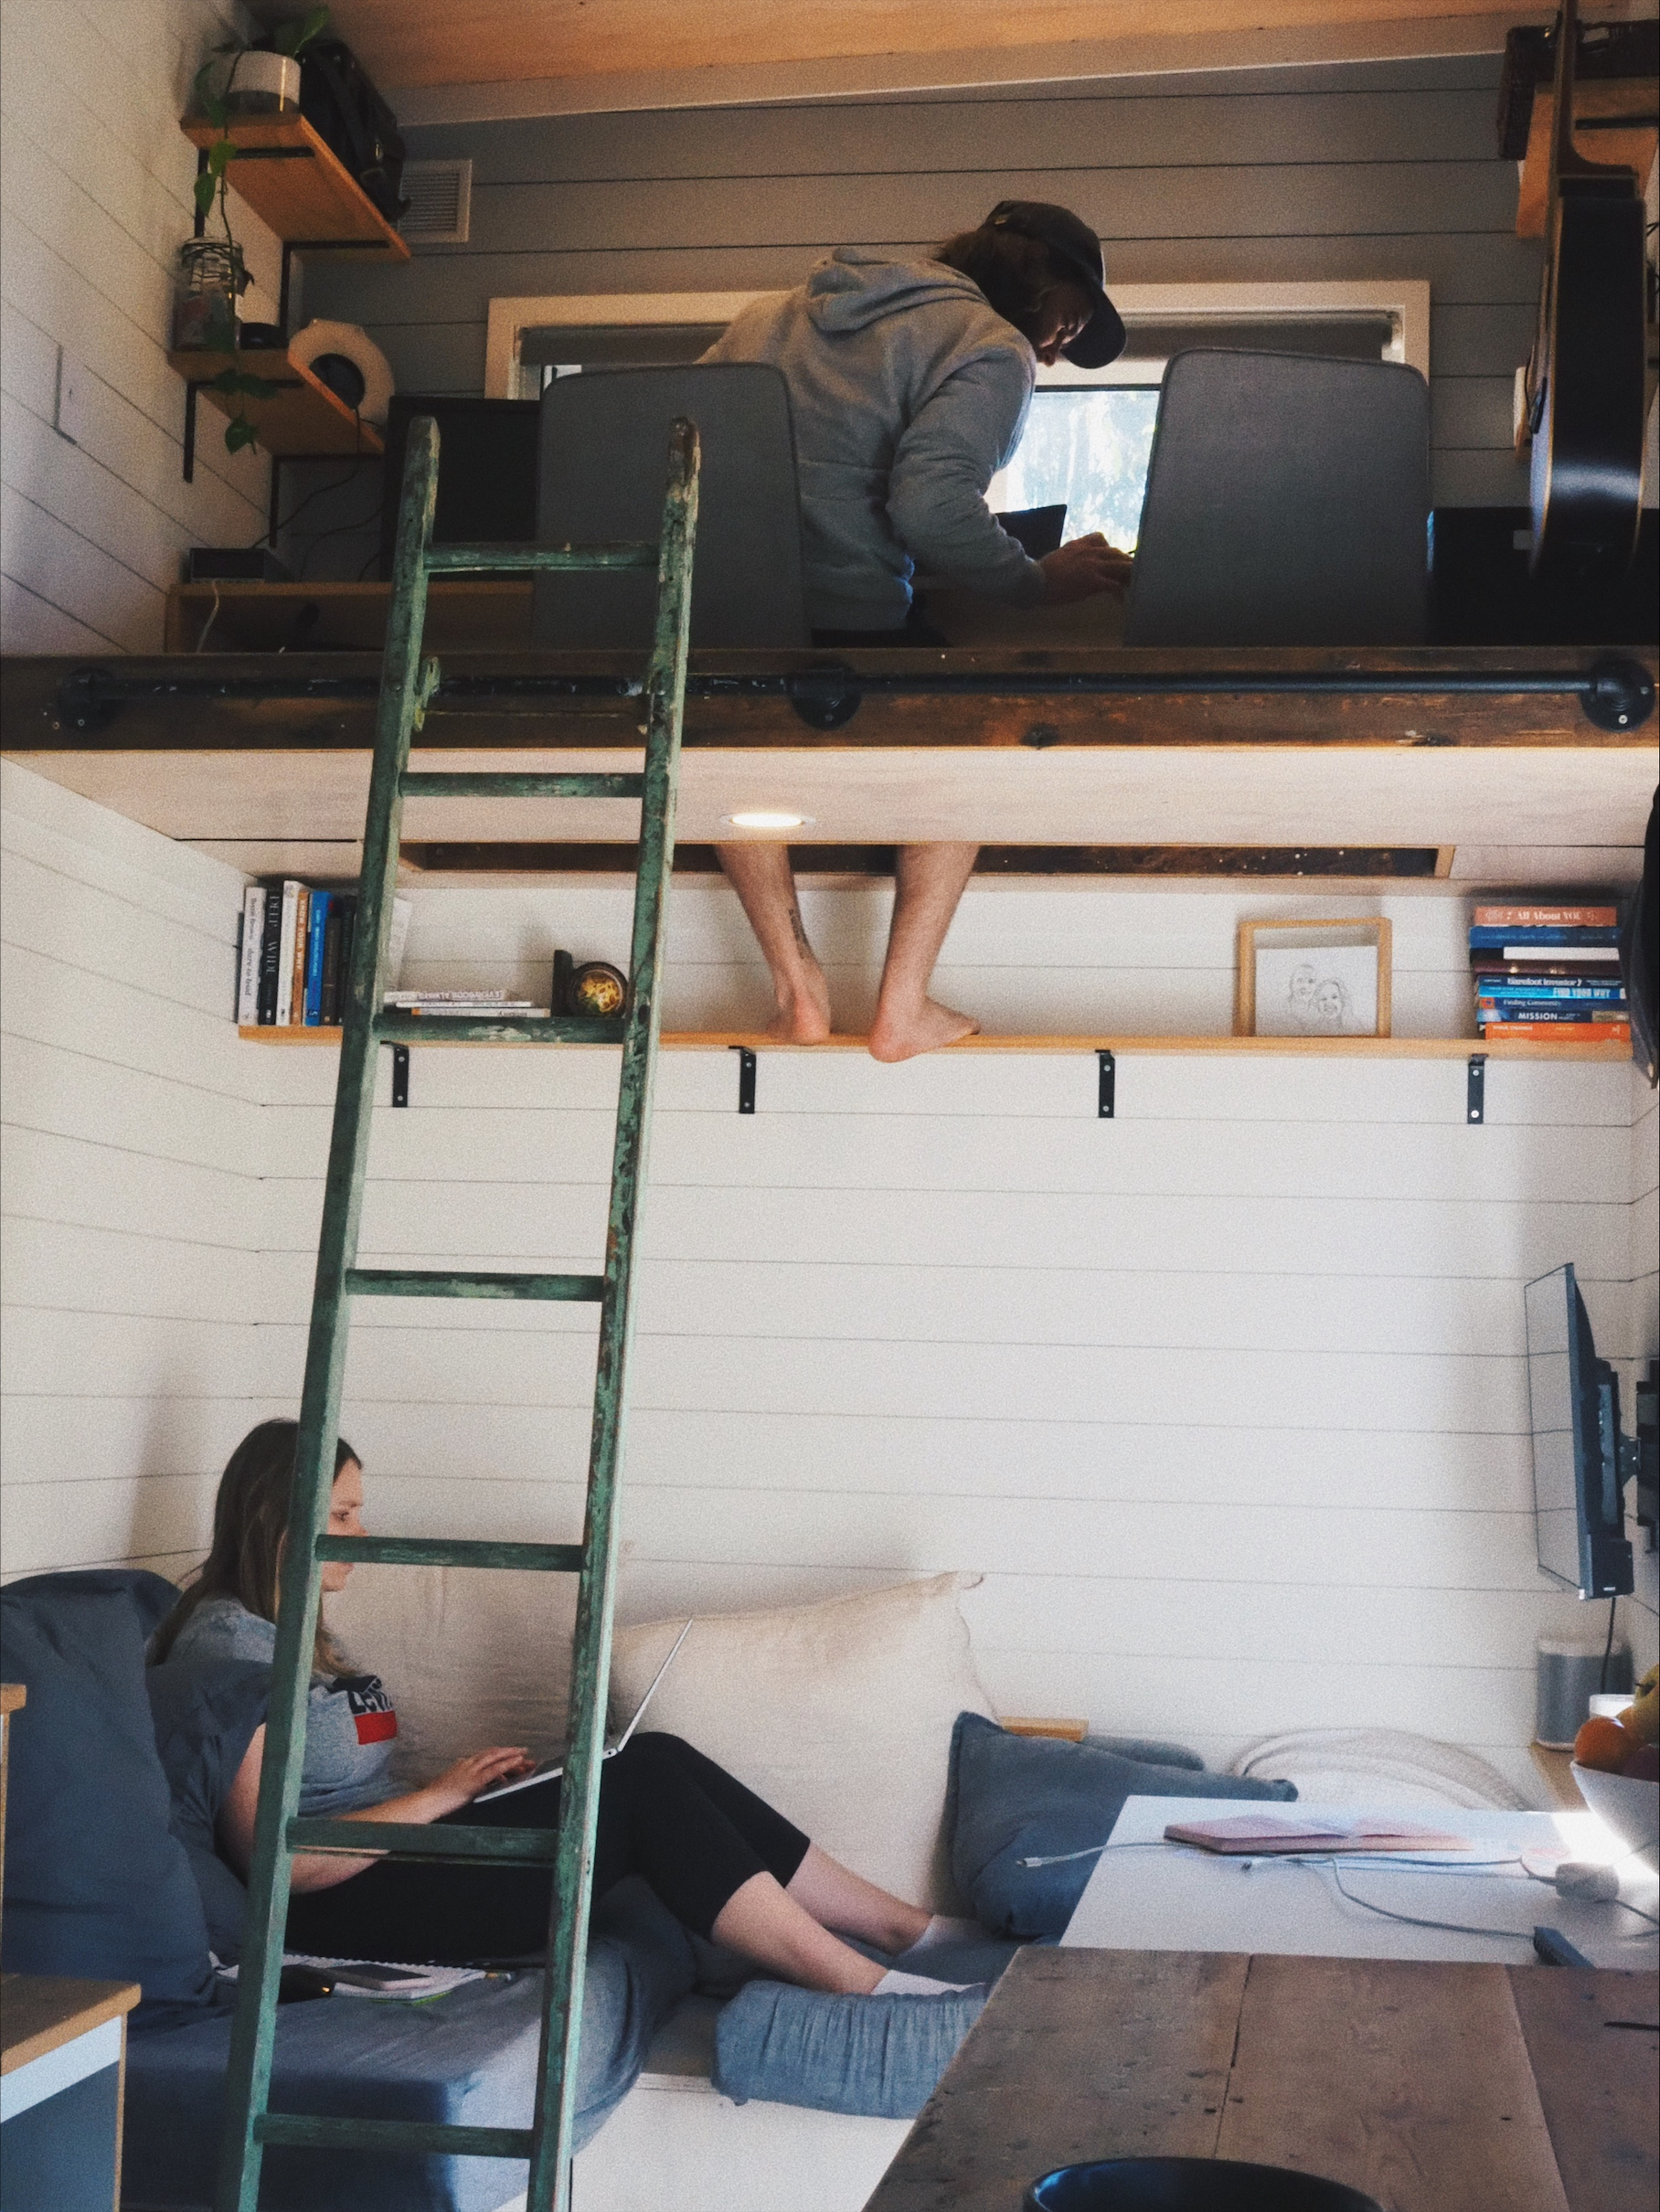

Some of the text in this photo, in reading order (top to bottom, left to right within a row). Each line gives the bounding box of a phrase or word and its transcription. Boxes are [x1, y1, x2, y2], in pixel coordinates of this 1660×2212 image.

[268, 895, 280, 927] DEEP
[1517, 911, 1530, 920] All
[1533, 911, 1561, 920] About
[266, 941, 277, 975] WIDE
[1506, 977, 1543, 985] barefoot
[1553, 988, 1570, 996] FIND
[1572, 989, 1591, 997] YOUR
[1593, 989, 1611, 998] WHY
[1518, 1012, 1558, 1021] MISSION
